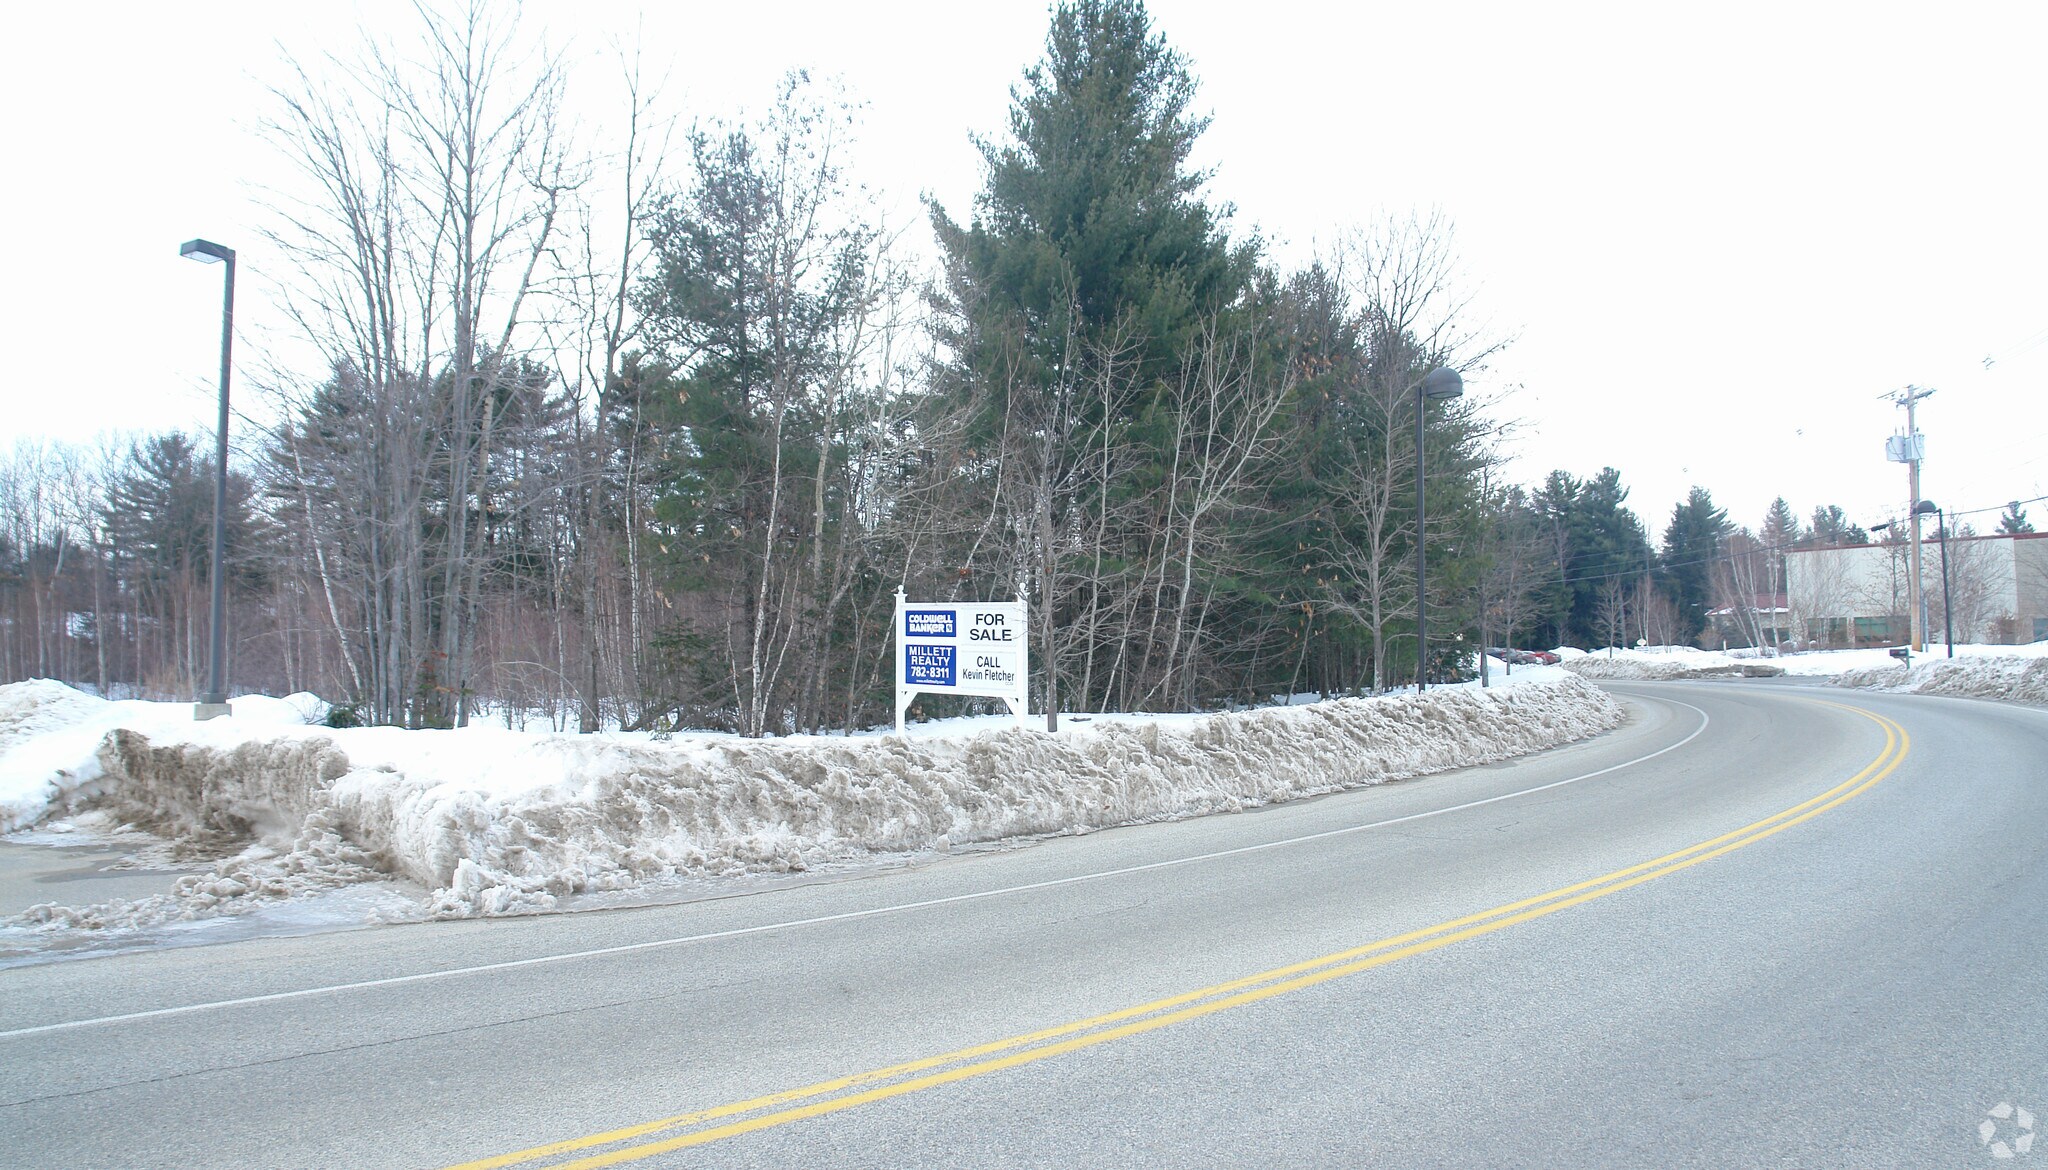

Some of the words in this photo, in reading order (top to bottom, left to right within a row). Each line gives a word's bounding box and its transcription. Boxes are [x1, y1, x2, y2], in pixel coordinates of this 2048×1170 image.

[976, 614, 1004, 625] FOR
[970, 629, 1012, 641] SALE
[909, 646, 952, 657] MILLETT
[911, 656, 950, 666] REALTY
[977, 656, 1001, 667] CALL
[911, 666, 950, 678] 782-8311
[963, 669, 983, 680] Kevin
[984, 669, 1014, 681] Fletcher
